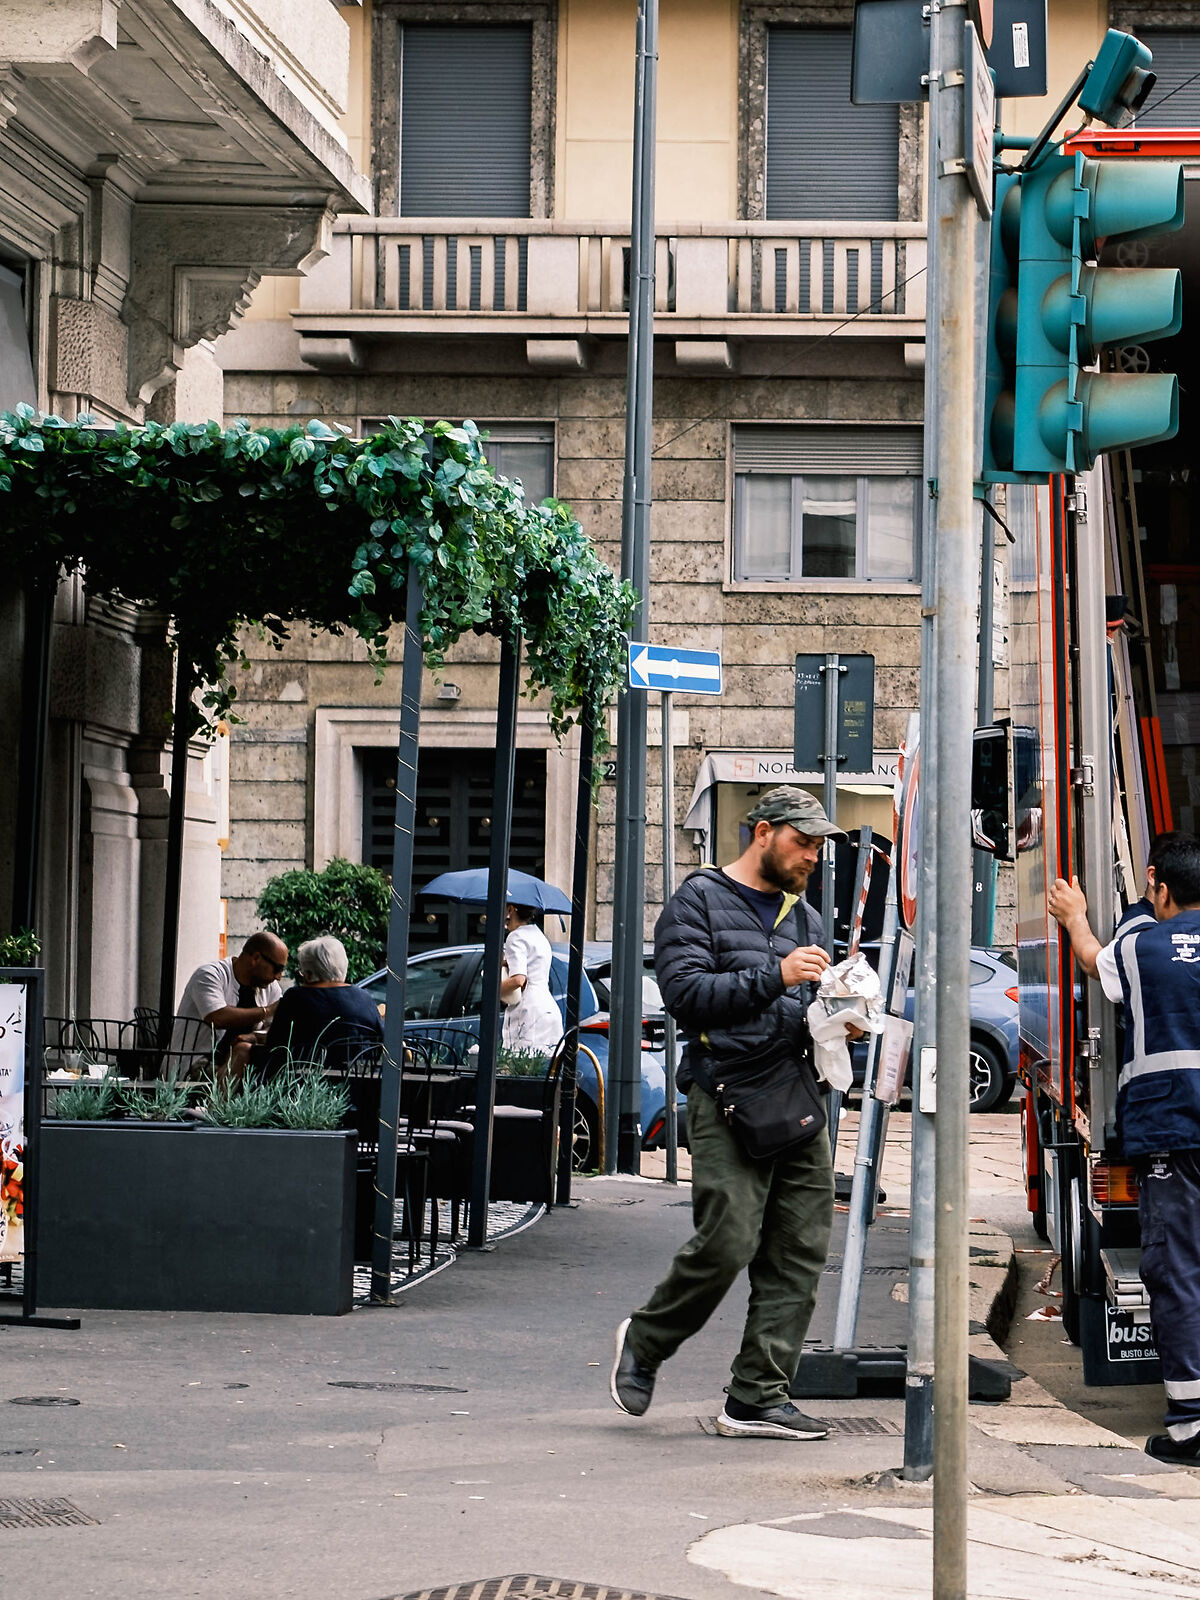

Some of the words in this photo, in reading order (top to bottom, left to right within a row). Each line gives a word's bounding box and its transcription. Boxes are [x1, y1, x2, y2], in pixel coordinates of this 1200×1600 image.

[975, 881, 983, 893] 8
[1109, 1322, 1153, 1343] bus
[1120, 1350, 1142, 1358] BUSTO
